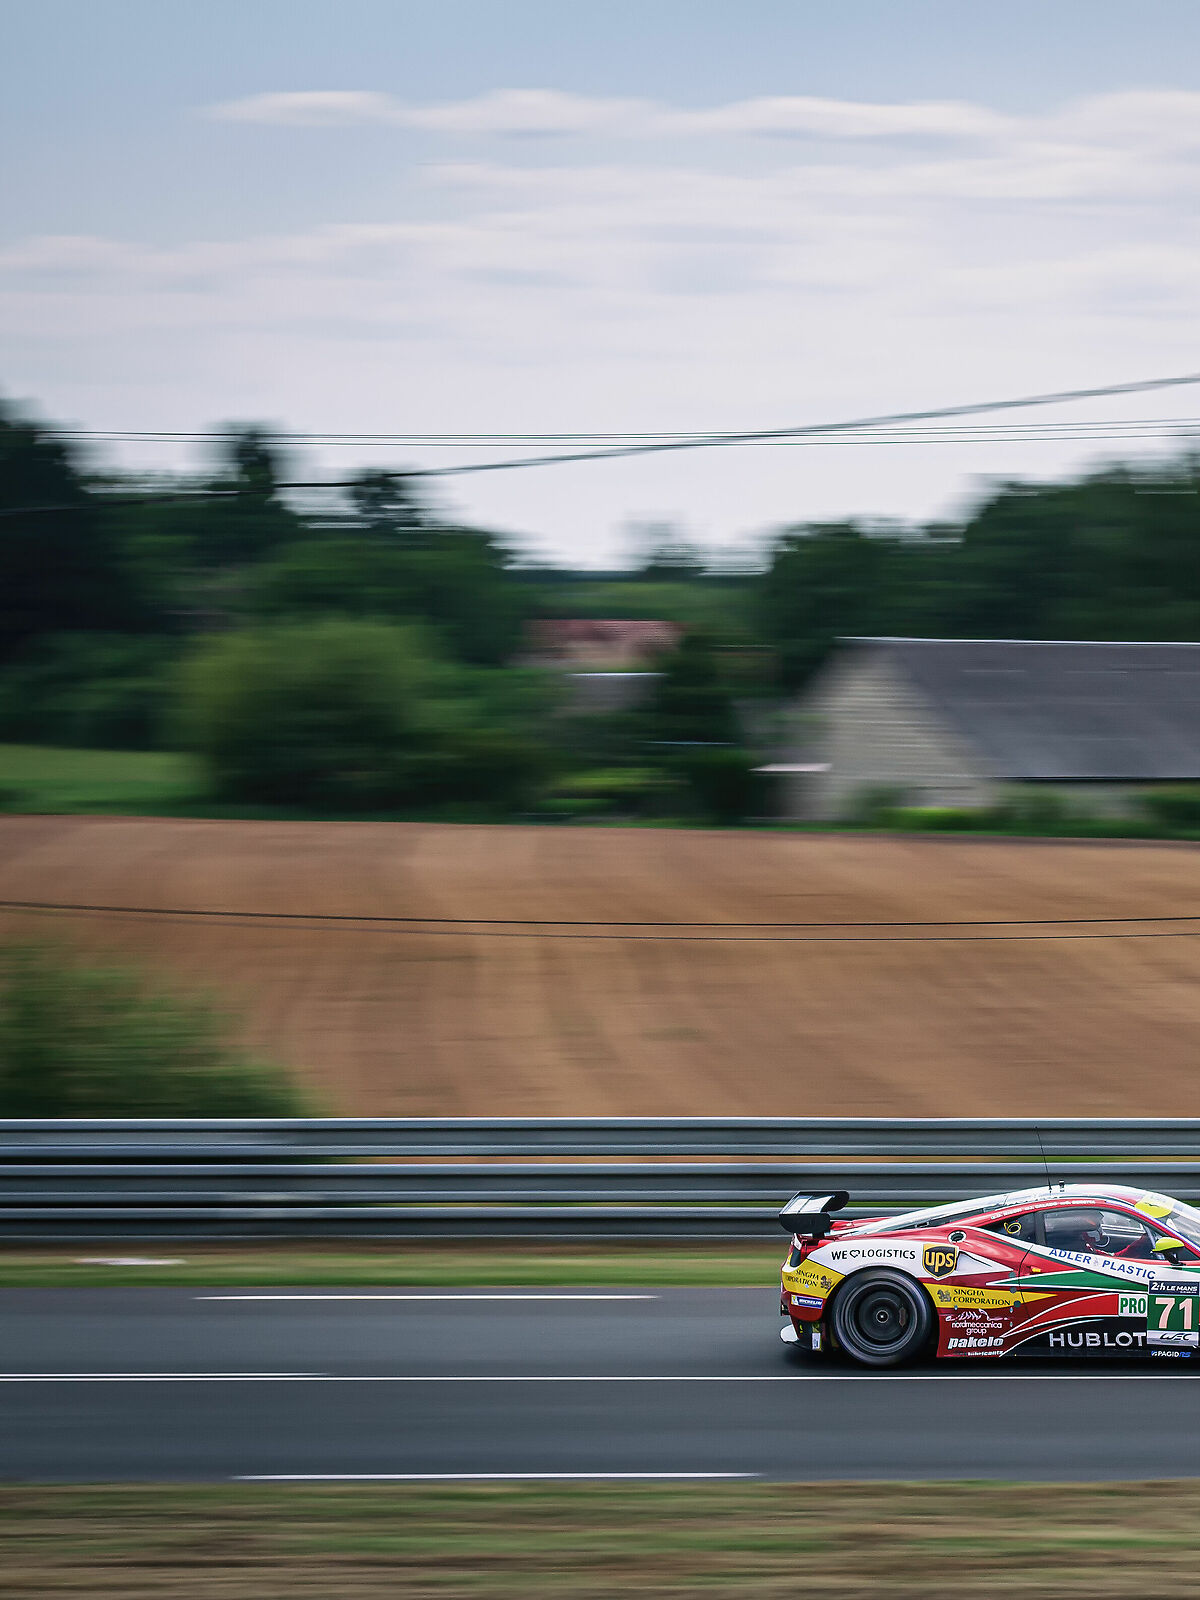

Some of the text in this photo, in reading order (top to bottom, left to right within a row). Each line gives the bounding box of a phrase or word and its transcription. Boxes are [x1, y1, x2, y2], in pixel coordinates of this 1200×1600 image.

[831, 1249, 916, 1261] WE LOGISTICS
[925, 1251, 955, 1273] ups
[1049, 1248, 1156, 1280] ADLER PLASTIC
[953, 1289, 985, 1297] SINGHA
[953, 1296, 1011, 1306] CORPORATION
[1120, 1297, 1147, 1314] PRO
[1155, 1297, 1193, 1330] 71
[951, 1320, 1003, 1329] nordmeccanica
[966, 1328, 987, 1336] group
[947, 1336, 1004, 1349] pakelo
[1049, 1331, 1147, 1347] HUBLOT
